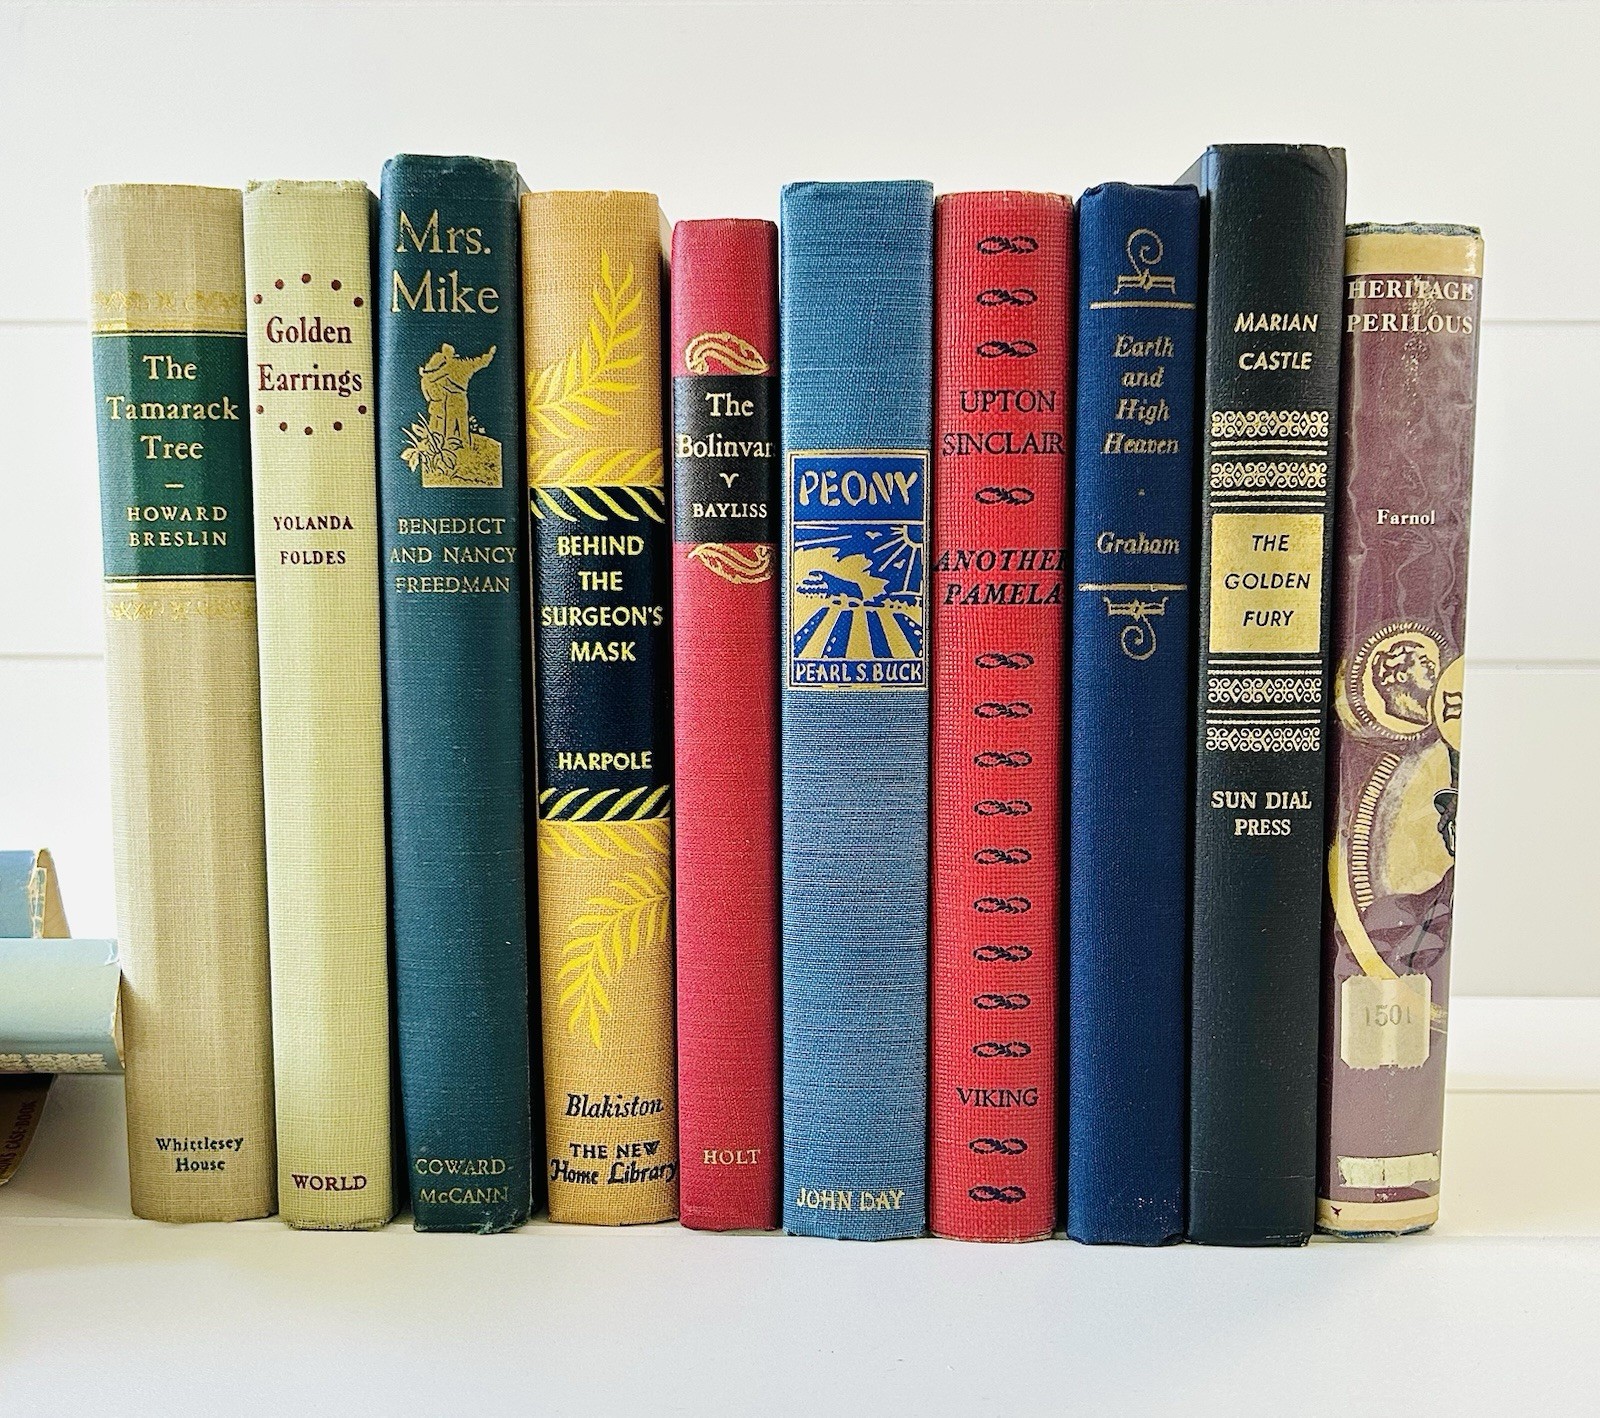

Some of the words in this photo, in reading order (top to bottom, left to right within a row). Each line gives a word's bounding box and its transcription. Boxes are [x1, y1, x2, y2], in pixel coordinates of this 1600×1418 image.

[395, 210, 493, 255] Mrs.
[391, 270, 500, 315] Mike
[1347, 279, 1475, 301] HERITAGE
[266, 315, 354, 345] Golden
[1233, 312, 1319, 333] MARIAN
[1346, 314, 1474, 334] PERILOUS
[1113, 333, 1176, 359] Earth
[142, 355, 198, 382] The
[1238, 351, 1314, 371] CASTLE
[256, 363, 364, 398] Earrings
[1121, 366, 1165, 389] and
[106, 395, 241, 423] Tamarack
[705, 392, 755, 417] The
[960, 389, 1056, 413] UPTON
[1115, 397, 1171, 426] High
[140, 435, 204, 461] Tree
[942, 431, 1066, 456] SINCLAIR
[1100, 432, 1180, 455] Heaven
[798, 470, 919, 507] PEONY
[126, 505, 229, 524] HOWARD
[691, 502, 769, 520] BAYLISS
[1376, 508, 1437, 527] Farnol
[272, 514, 355, 532] YOLANDA
[397, 517, 507, 537] BENEDICT
[128, 530, 228, 549] BRESLIN
[556, 534, 646, 557] BEHIND
[1095, 530, 1182, 556] Graham
[1252, 534, 1291, 552] THE
[280, 550, 347, 567] FOLDES
[389, 546, 434, 566] AND
[442, 546, 518, 567] NANCY
[395, 576, 511, 595] FREEDMAN
[577, 570, 624, 592] THE
[1224, 572, 1312, 592] GOLDEN
[942, 582, 1068, 606] PAMELA
[541, 605, 664, 628] SURGEON'S
[1242, 609, 1295, 628] FURY
[570, 641, 638, 663] MASK
[795, 662, 853, 684] PEARL
[856, 662, 870, 684] S.
[875, 660, 922, 683] BUCK
[557, 751, 653, 772] HARPOLE
[1210, 791, 1258, 811] SUN
[1265, 791, 1313, 811] DIAL
[1233, 818, 1292, 837] PRESS
[1363, 1003, 1413, 1028] 1501
[565, 1092, 664, 1119] Blakiston
[955, 1087, 1040, 1108] VIKING
[155, 1135, 244, 1156] Whittlesey
[569, 1140, 610, 1161] THE
[616, 1138, 661, 1159] NEW
[175, 1156, 227, 1174] House
[414, 1157, 507, 1177] COWARD
[702, 1148, 762, 1166] HOLT
[291, 1173, 368, 1193] WORLD
[549, 1158, 600, 1186] Home
[606, 1160, 679, 1184] Library
[419, 1184, 509, 1205] McCANN
[796, 1188, 853, 1214] JOHN
[859, 1188, 905, 1212] DAY
